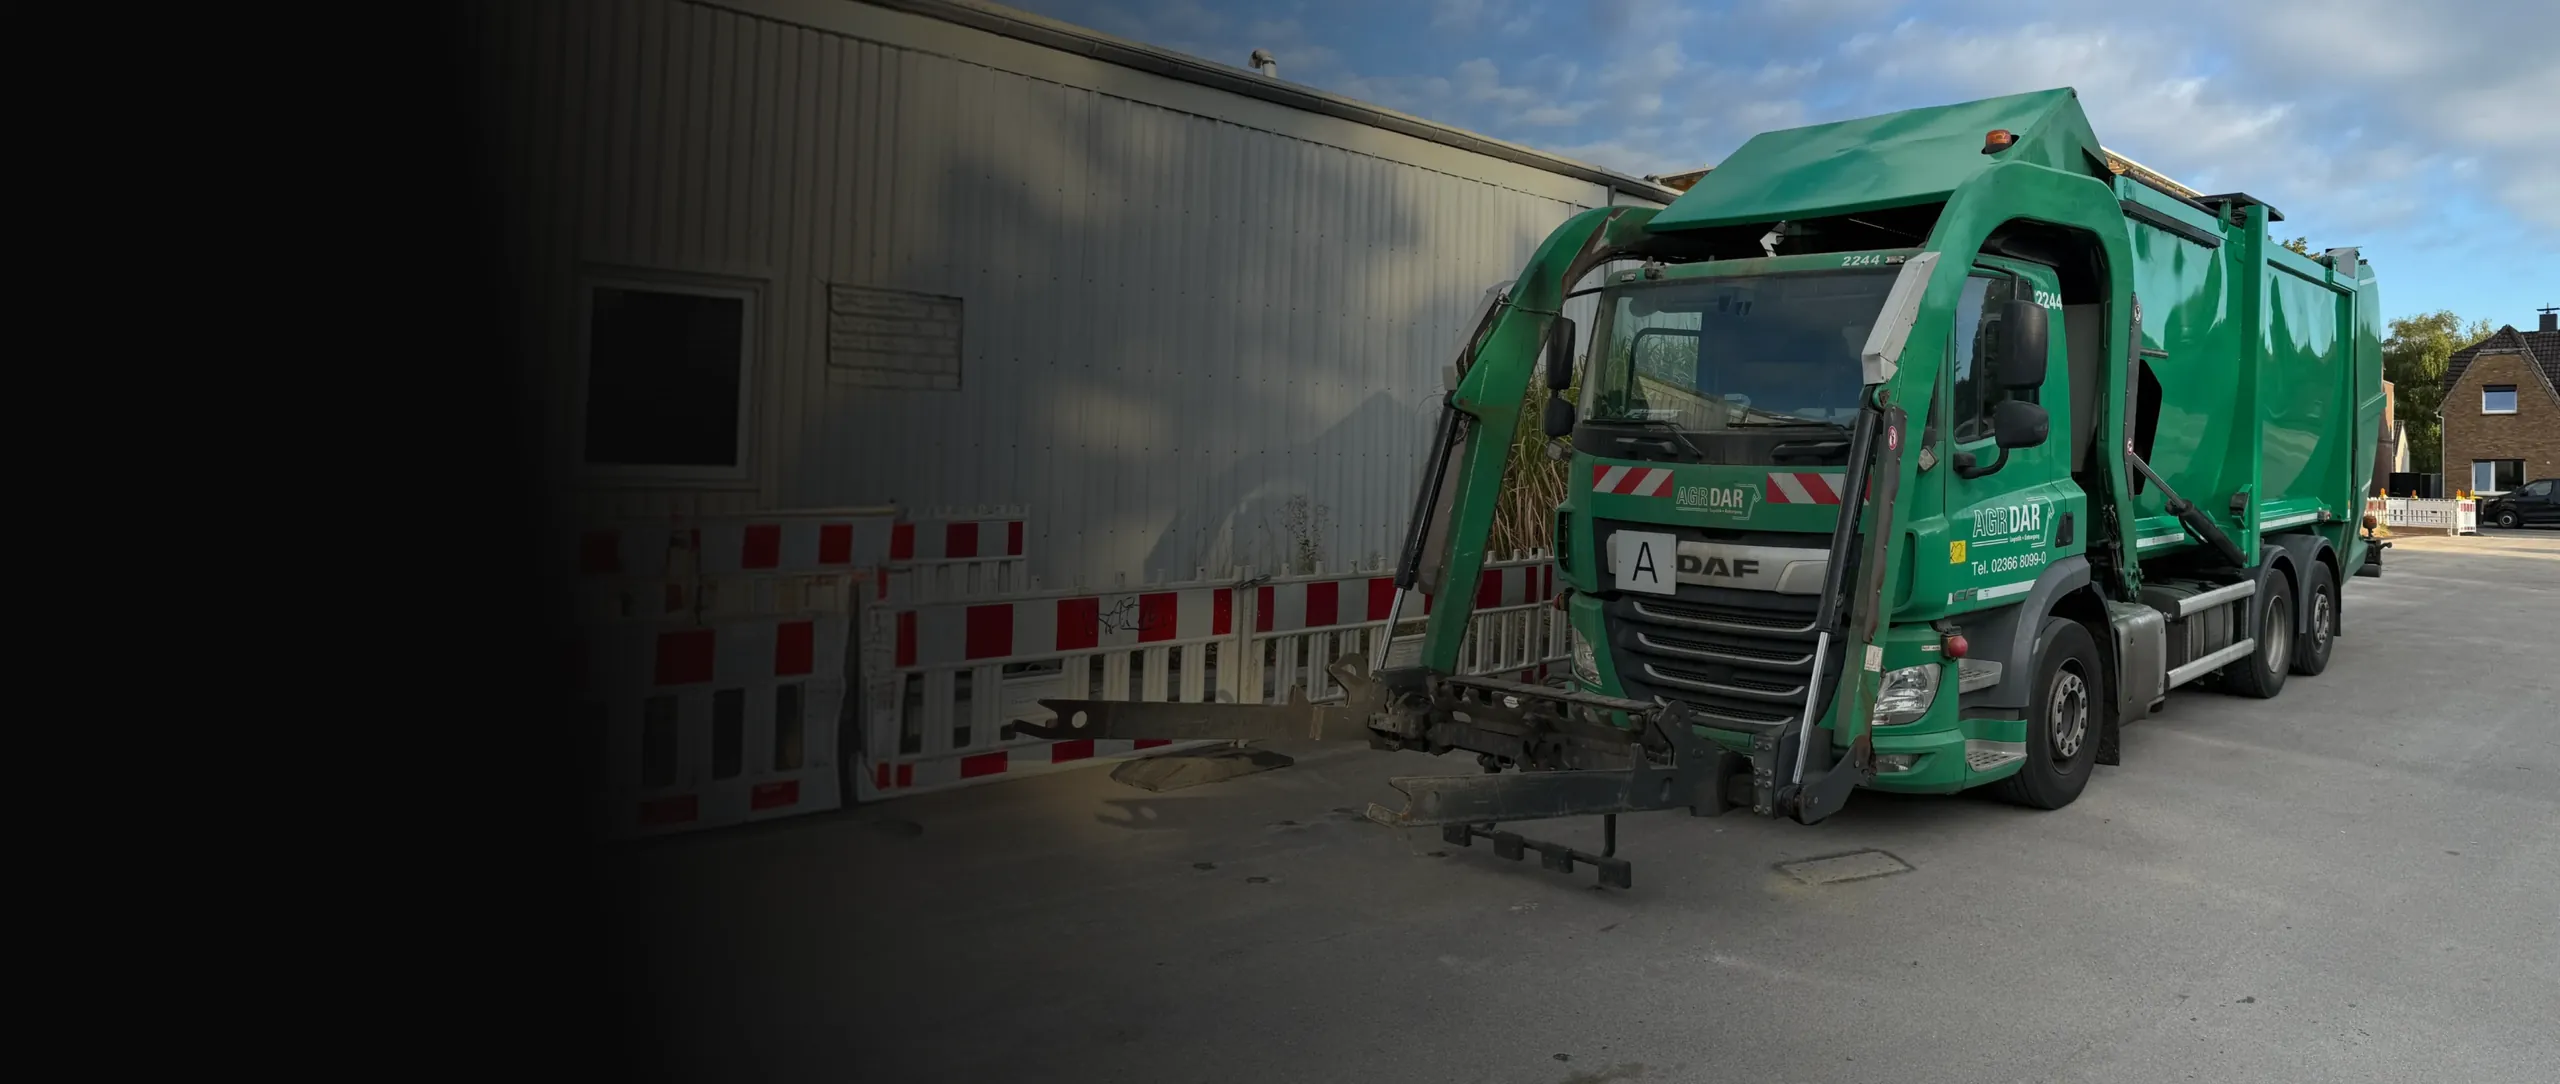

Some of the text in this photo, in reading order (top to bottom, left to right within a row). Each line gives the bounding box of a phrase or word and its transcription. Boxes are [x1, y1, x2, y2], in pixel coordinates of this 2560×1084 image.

[1841, 255, 1880, 267] 2244
[2036, 290, 2063, 310] 2244
[1632, 541, 1658, 584] A
[1677, 554, 1759, 578] DAF
[1972, 551, 2046, 576] Tel. 02366 8099-0
